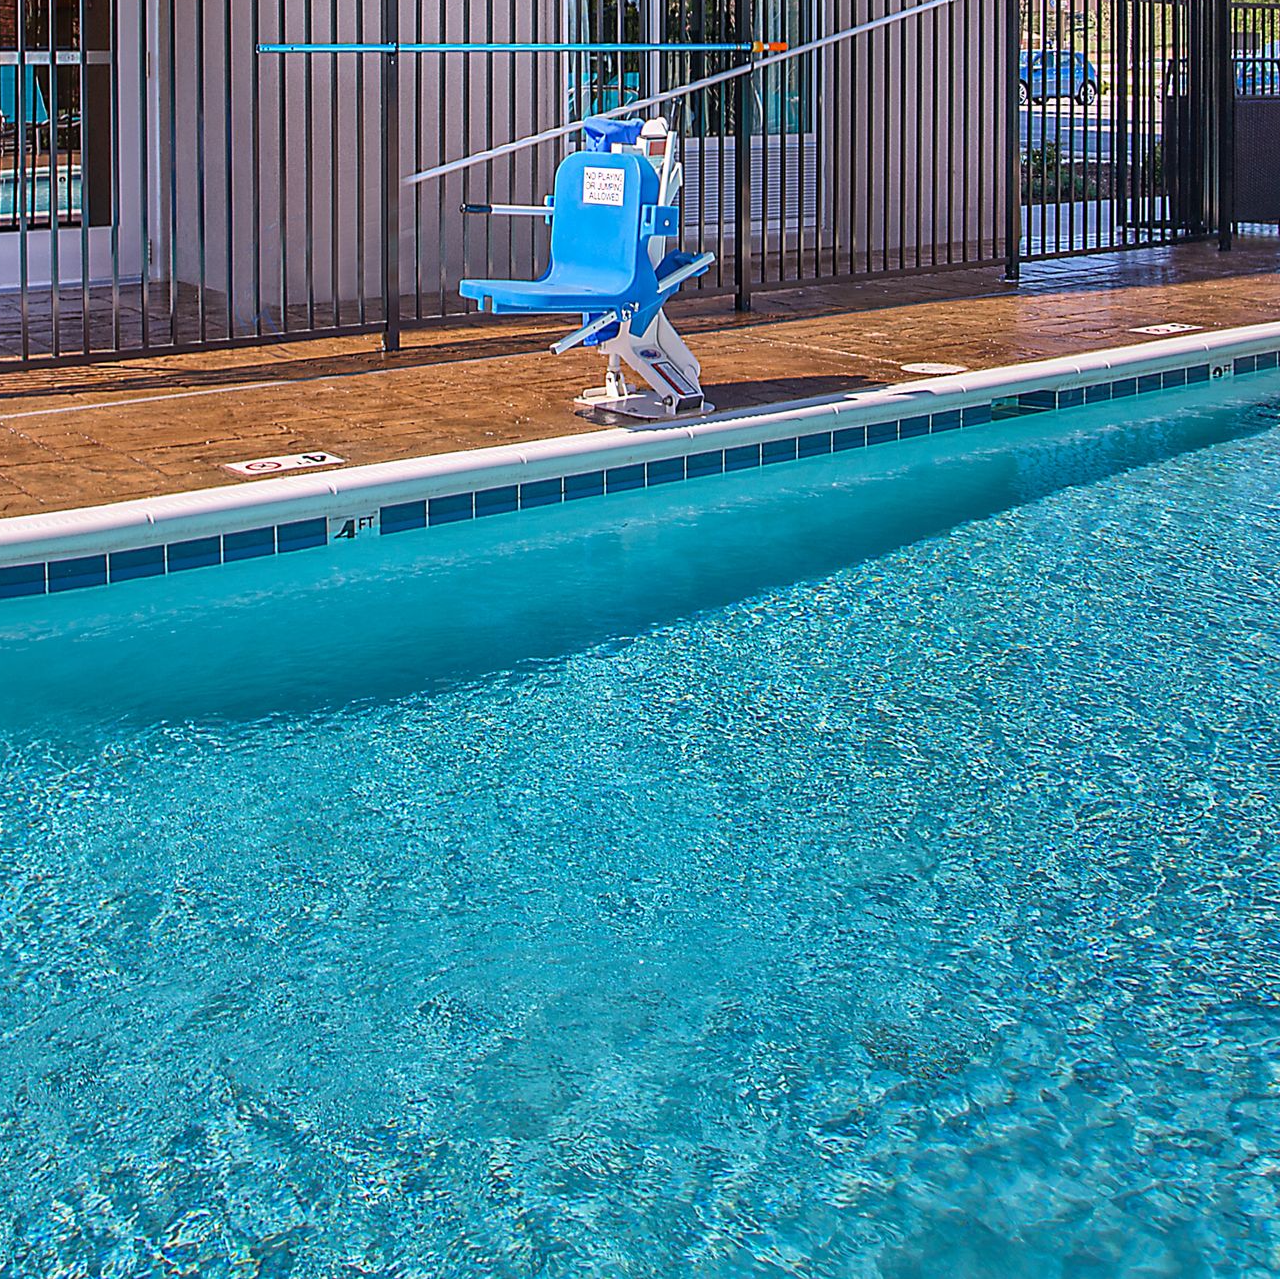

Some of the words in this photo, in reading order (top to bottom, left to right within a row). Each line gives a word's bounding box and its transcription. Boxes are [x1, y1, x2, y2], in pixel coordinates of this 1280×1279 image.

[585, 172, 596, 180] NO
[598, 172, 624, 182] PLAYING
[585, 181, 595, 190] OR
[597, 182, 623, 192] JUMPING
[589, 191, 620, 201] ALLOWED
[333, 519, 355, 539] 4
[358, 516, 375, 530] FT
